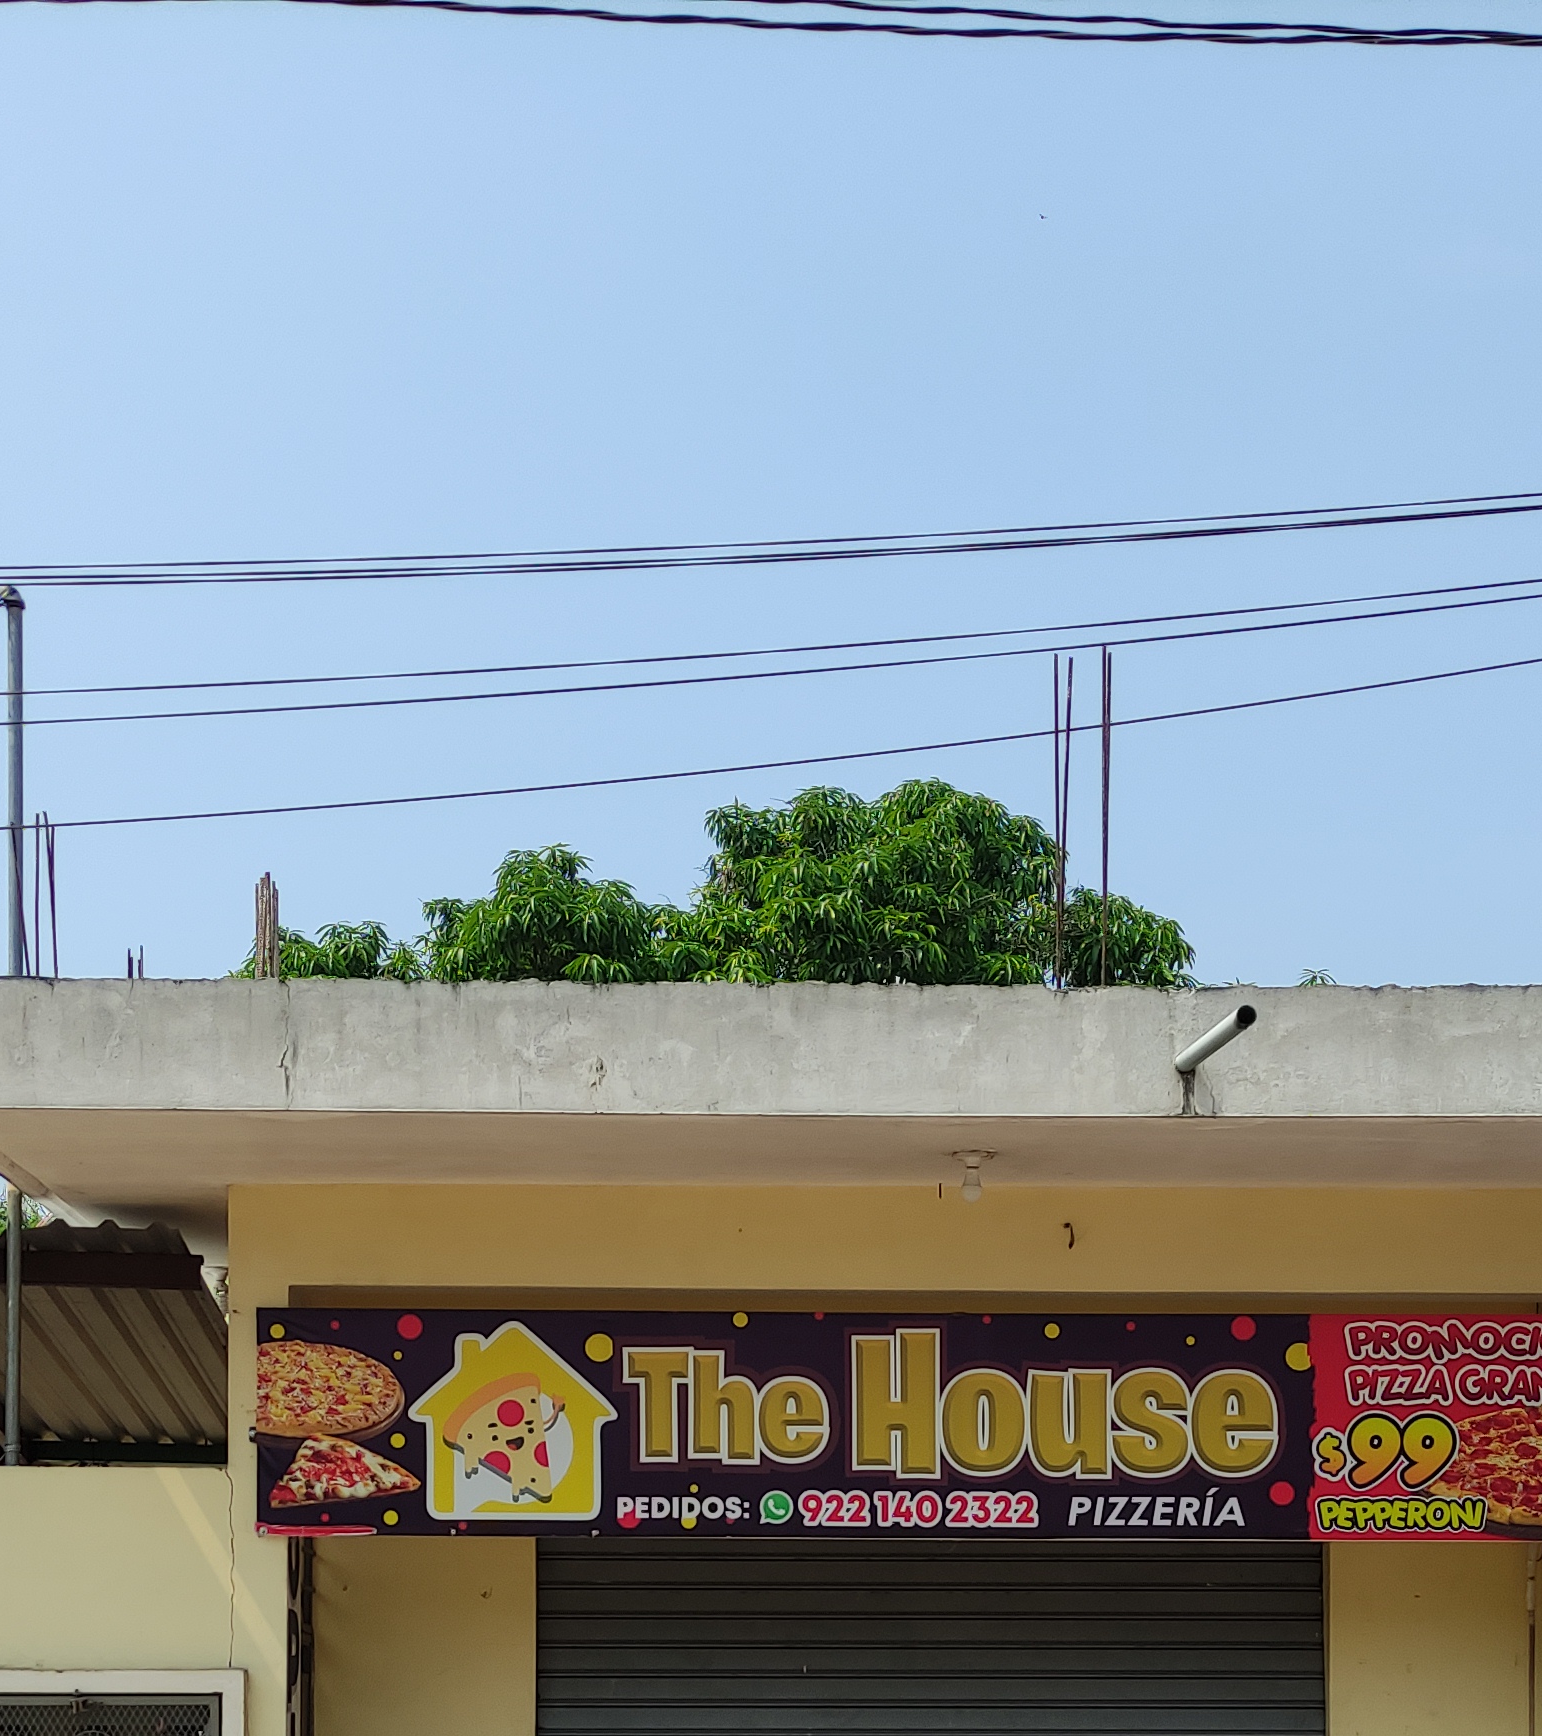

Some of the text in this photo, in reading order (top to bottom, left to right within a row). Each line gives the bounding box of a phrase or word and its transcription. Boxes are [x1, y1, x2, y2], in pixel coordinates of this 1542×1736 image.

[623, 1328, 1279, 1480] The House
[1346, 1365, 1452, 1405] PIZZA
[1313, 1411, 1459, 1491] $99
[617, 1492, 1038, 1527] PEDIDOS: 922 140 2322
[1067, 1487, 1245, 1527] PIZZERÍA
[1317, 1497, 1487, 1531] PEPPERONI
